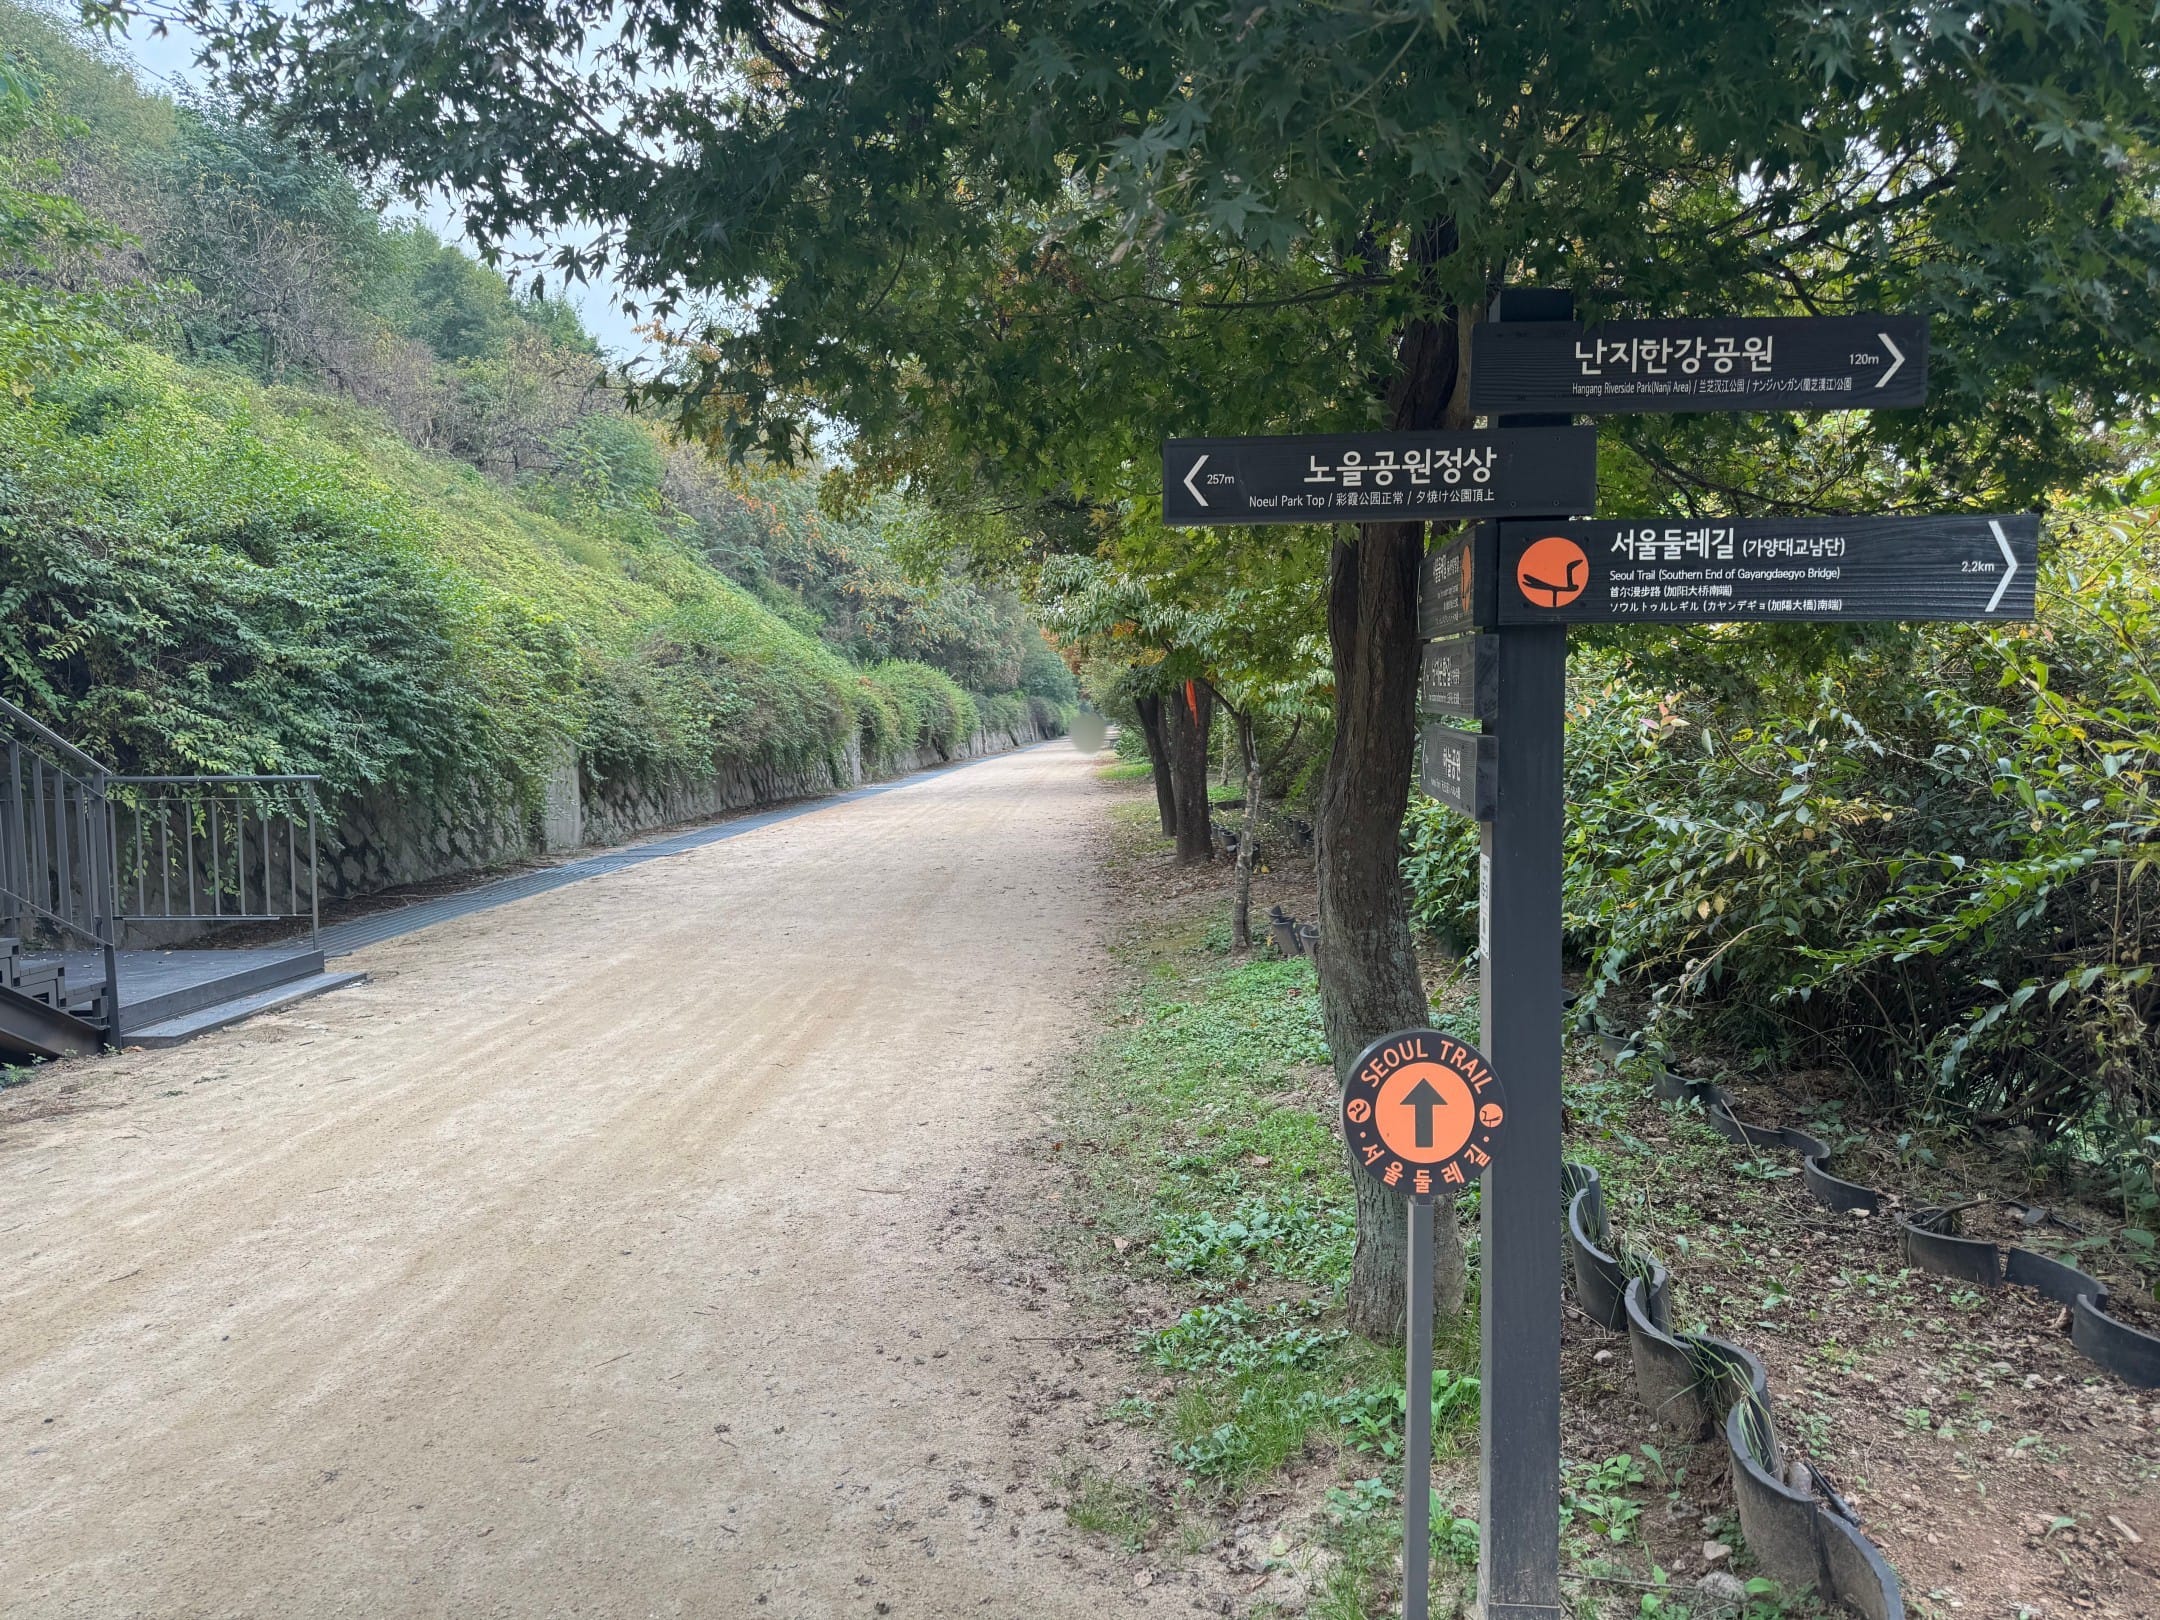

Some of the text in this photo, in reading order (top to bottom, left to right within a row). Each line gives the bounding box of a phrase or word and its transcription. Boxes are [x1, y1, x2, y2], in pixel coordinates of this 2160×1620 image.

[1575, 336, 1773, 375] 난지한강공원
[1849, 353, 1880, 366] 120m
[1572, 382, 1602, 397] Hangang
[1604, 381, 1635, 395] Riverside
[1636, 380, 1672, 396] Park(Nanji
[1673, 379, 1692, 394] Area)
[1303, 447, 1498, 487] 노을공원정상
[1207, 474, 1235, 485] 257m
[1249, 495, 1278, 508] Noeul
[1281, 494, 1304, 507] Park
[1306, 493, 1325, 508] Top
[1610, 527, 1846, 560] 서울둘레길 (가양대교남단)
[1609, 566, 1841, 582] Seoul Trail (Southern End of Gayangdaegyo Bridge)
[1961, 560, 1995, 573] 2.2km
[1360, 1038, 1493, 1095] SEOUL TRAIL
[1362, 1143, 1493, 1194] 서울둘레길
